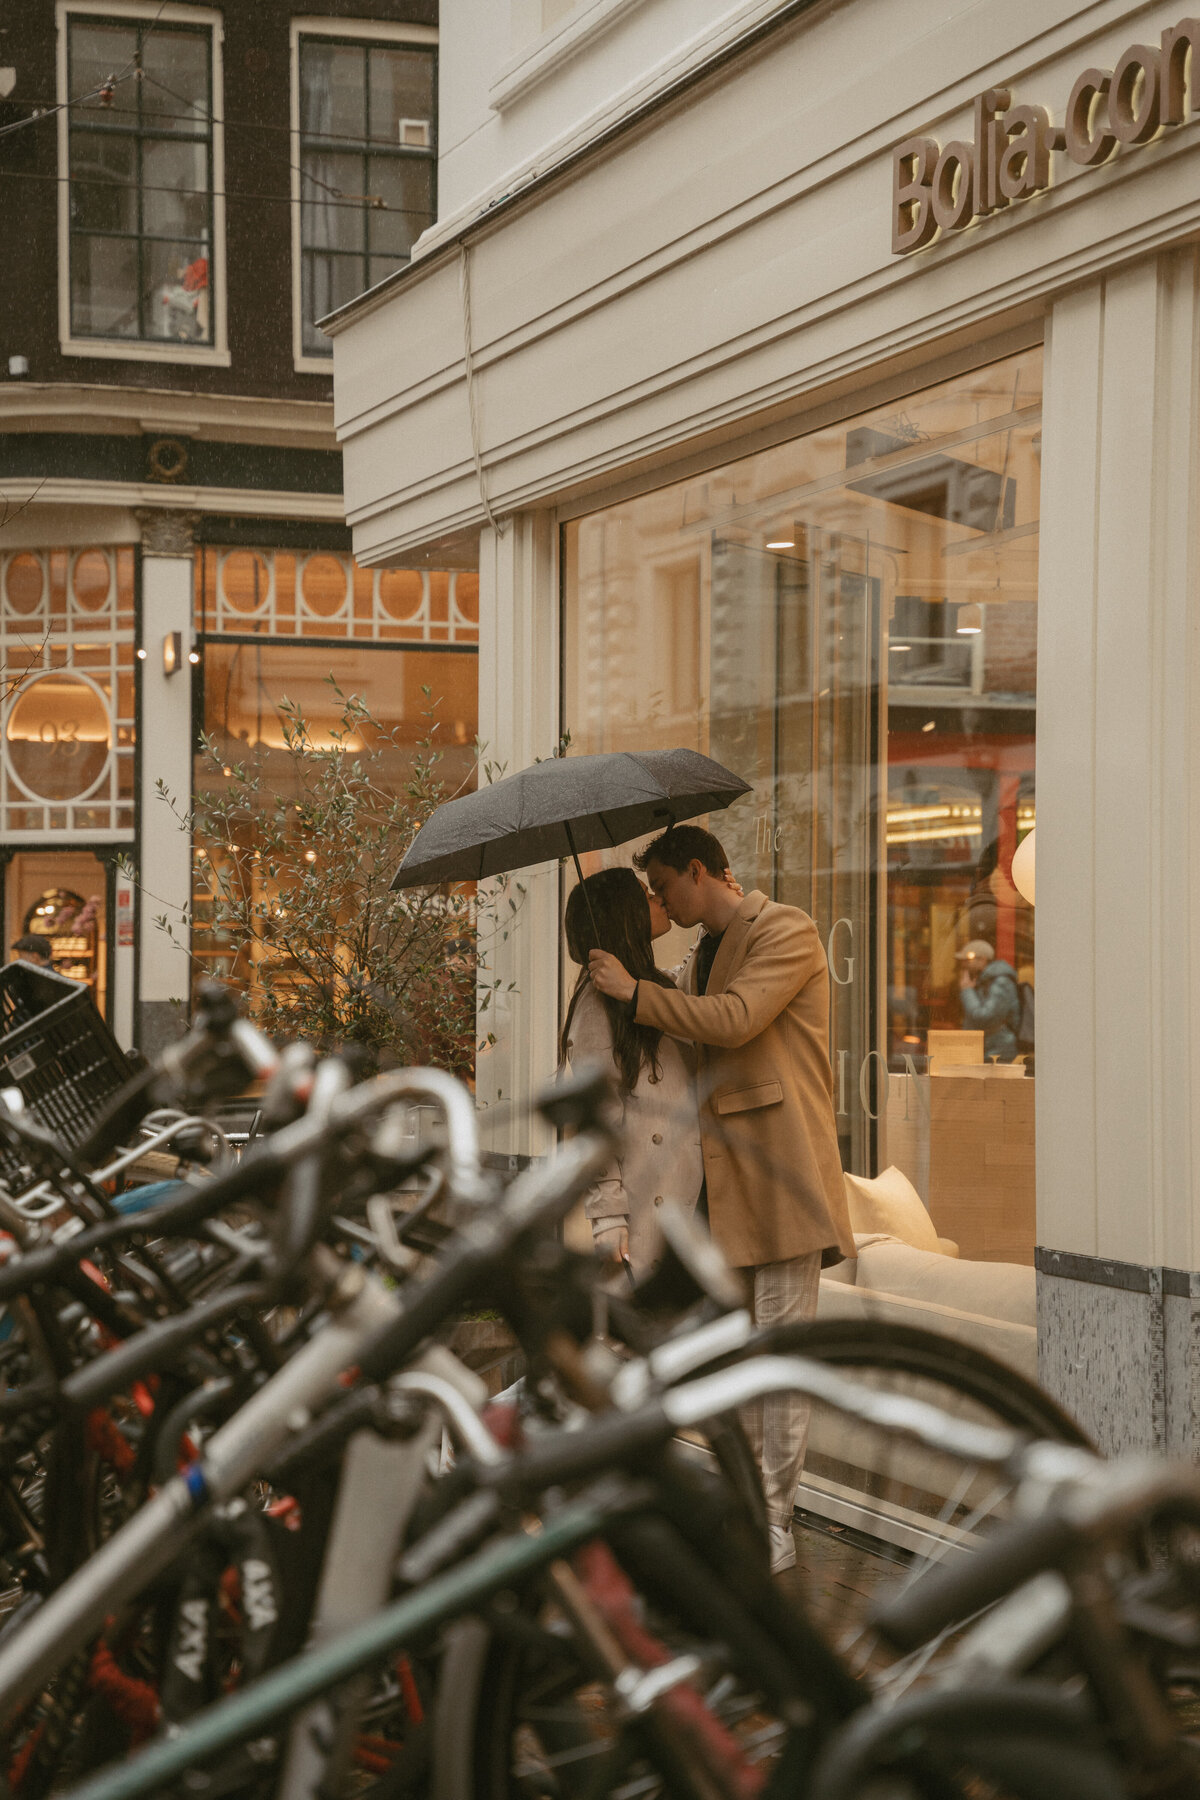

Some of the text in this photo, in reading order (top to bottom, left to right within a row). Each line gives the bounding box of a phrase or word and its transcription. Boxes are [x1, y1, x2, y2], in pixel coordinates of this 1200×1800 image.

[753, 813, 783, 855] The
[836, 1050, 935, 1122] ION
[174, 1599, 209, 1682] AXA
